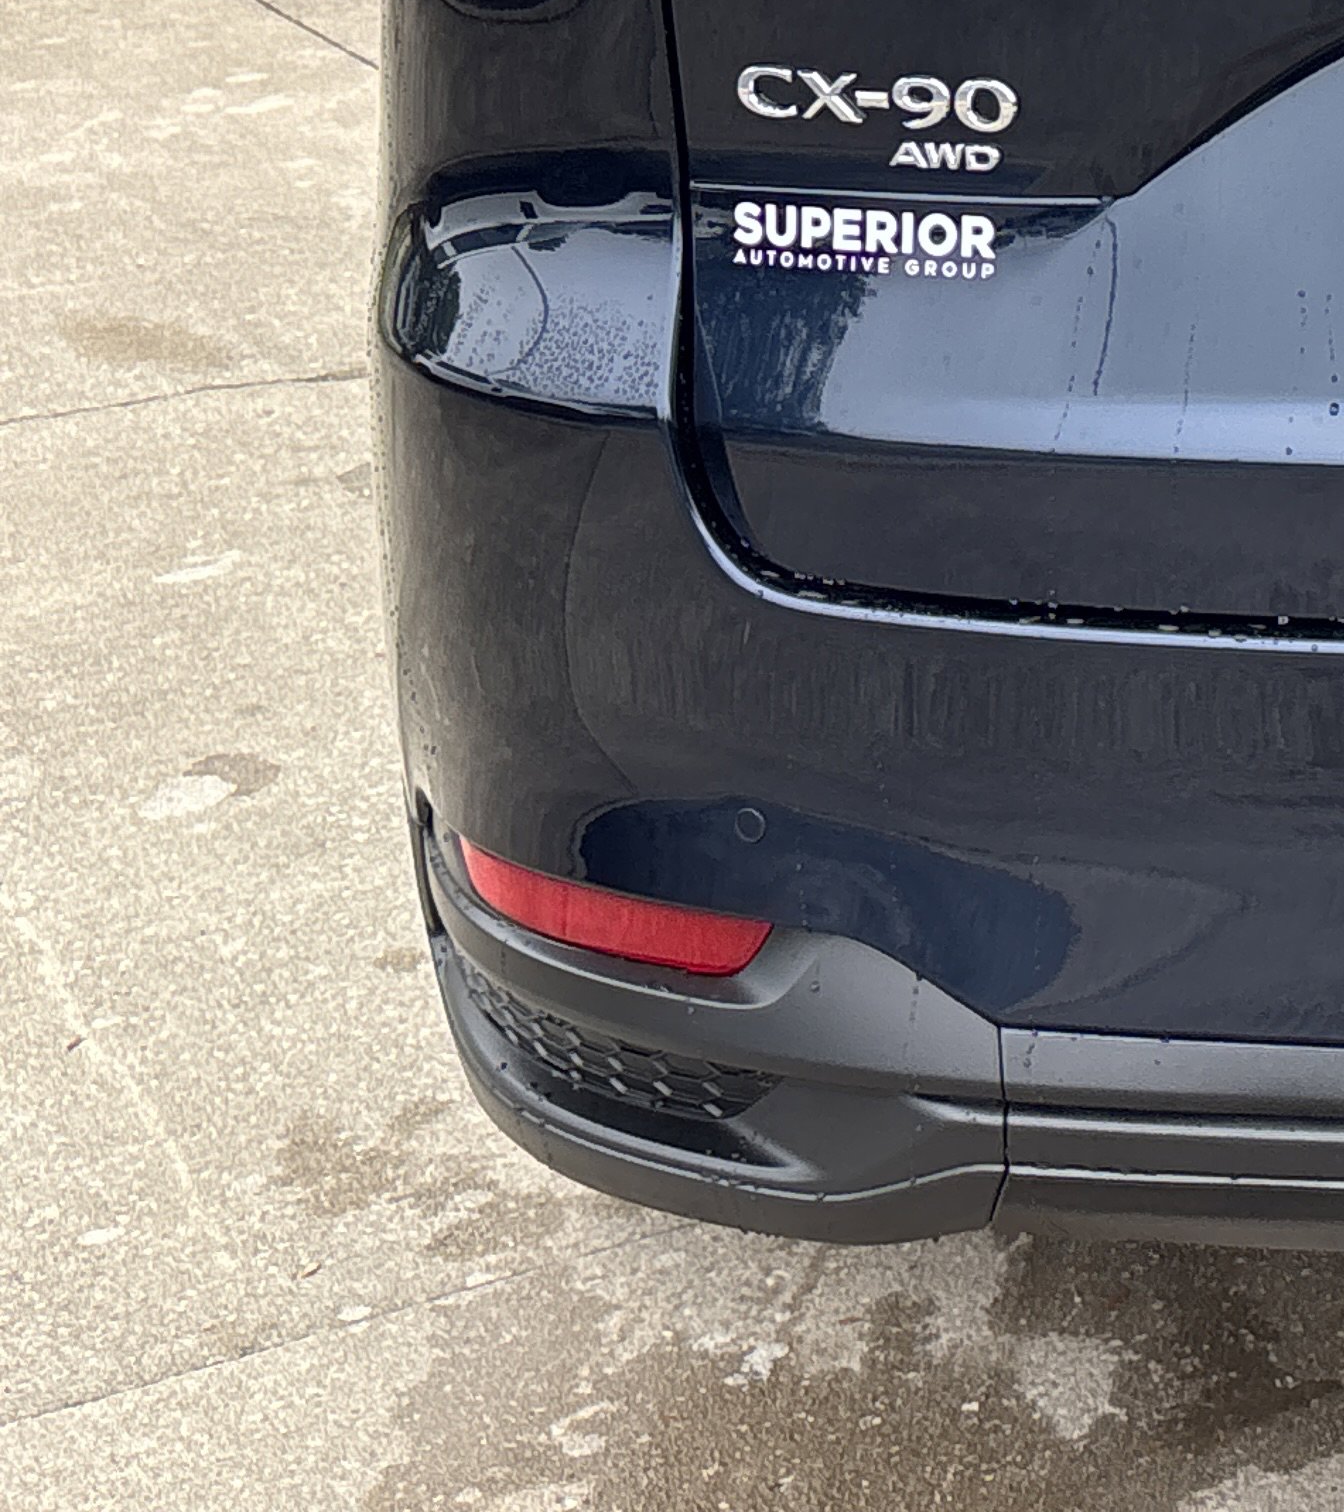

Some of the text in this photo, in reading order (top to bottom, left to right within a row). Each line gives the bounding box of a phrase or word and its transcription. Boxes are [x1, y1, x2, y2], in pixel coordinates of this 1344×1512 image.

[737, 65, 1018, 133] CX-90
[889, 141, 1001, 171] AWD
[733, 201, 996, 260] SUPERIOR
[733, 248, 995, 280] AUTOMOTIVE GROUP
